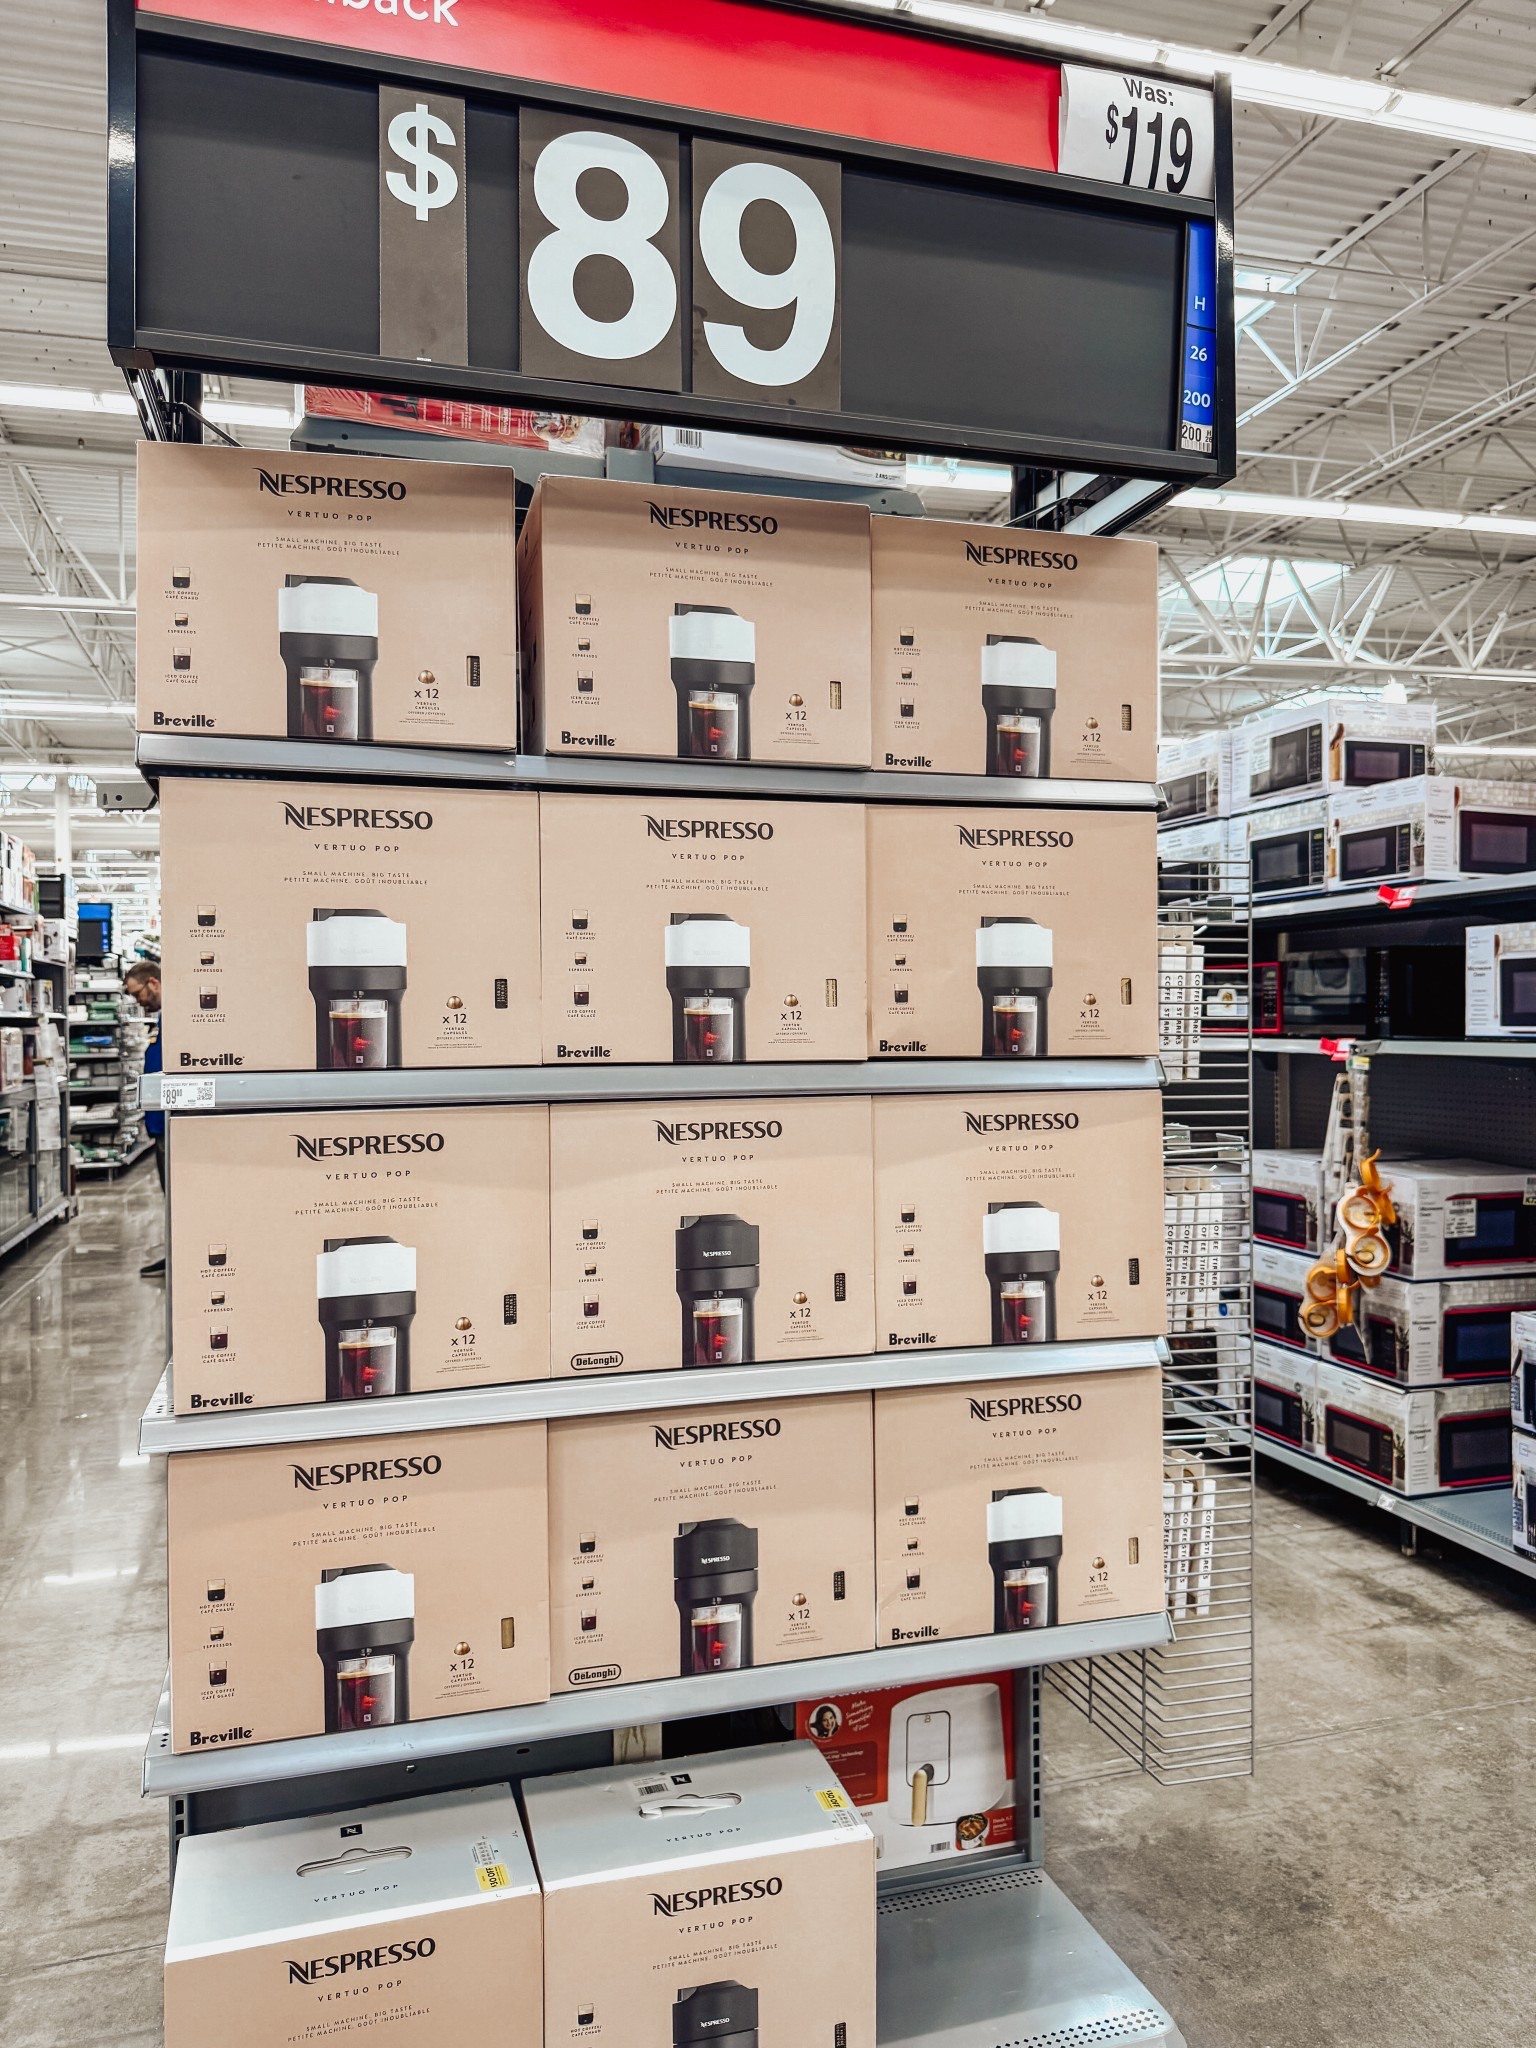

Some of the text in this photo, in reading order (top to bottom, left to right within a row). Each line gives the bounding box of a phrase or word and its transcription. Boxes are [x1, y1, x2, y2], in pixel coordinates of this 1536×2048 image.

[1122, 77, 1174, 106] Was:
[1105, 101, 1193, 195] $119
[1194, 296, 1206, 311] H
[1190, 345, 1208, 362] 26
[1183, 389, 1211, 408] 200
[1182, 424, 1202, 442] 200
[251, 467, 407, 501] NESPRESSO
[287, 510, 373, 522] VERTUO POP
[642, 500, 778, 536] NESPRESSO
[675, 542, 750, 555] VERTUO POP
[960, 540, 1078, 571] NESPRESSO
[987, 577, 1053, 589] VERTUO POP
[413, 687, 440, 699] x 12
[154, 711, 216, 728] Breville
[785, 709, 807, 721] x 12
[561, 730, 616, 747] Breville
[1081, 732, 1101, 742] x 12
[885, 753, 933, 768] Breville
[276, 801, 434, 831] NESPRESSO
[639, 814, 774, 842] NESPRESSO
[953, 824, 1074, 850] NESPRESSO
[314, 843, 400, 853] VERTUO POP
[671, 853, 717, 861] VERTUO
[442, 1013, 467, 1024] x 12
[780, 1010, 802, 1020] x 12
[1079, 1008, 1100, 1018] x 12
[557, 1044, 612, 1059] Breville
[880, 1039, 928, 1053] Breville
[180, 1052, 245, 1067] Breville
[959, 1111, 1080, 1136] NESPRESSO
[649, 1120, 783, 1146] NESPRESSO
[288, 1132, 445, 1162] NESPRESSO
[681, 1155, 726, 1163] VERTUO
[325, 1169, 411, 1181] VERTUO POP
[702, 1250, 732, 1258] NESPRESSO
[1087, 1289, 1108, 1301] x 12
[789, 1306, 811, 1318] x 12
[450, 1333, 476, 1347] x 12
[889, 1332, 937, 1346] Breville
[575, 1355, 620, 1368] DeLonghi
[190, 1392, 254, 1410] Breville
[963, 1394, 1083, 1422] NESPRESSO
[647, 1418, 783, 1451] NESPRESSO
[992, 1427, 1058, 1439] VERTUO POP
[679, 1454, 754, 1468] VERTUO POP
[285, 1455, 442, 1492] NESPRESSO
[322, 1494, 409, 1510] VERTUO POP
[701, 1556, 730, 1565] NESPRESSO
[1089, 1571, 1108, 1583] x 12
[788, 1607, 810, 1621] x 12
[892, 1626, 941, 1642] Breville
[449, 1657, 475, 1672] x 12
[573, 1667, 618, 1683] DeLonghi
[190, 1727, 254, 1747] Breville
[666, 1827, 742, 1842] VERTUO POP
[314, 1884, 399, 1903] VERTUO POP
[646, 1876, 783, 1918] NESPRESSO
[678, 1915, 754, 1935] VERTUO POP
[281, 1936, 436, 1986] NESPRESSO
[317, 1979, 403, 2003] VERTUO POP
[305, 2004, 413, 2032] SMALL MACHINE. BIG TASTE
[700, 2017, 730, 2028] NESPRESSO
